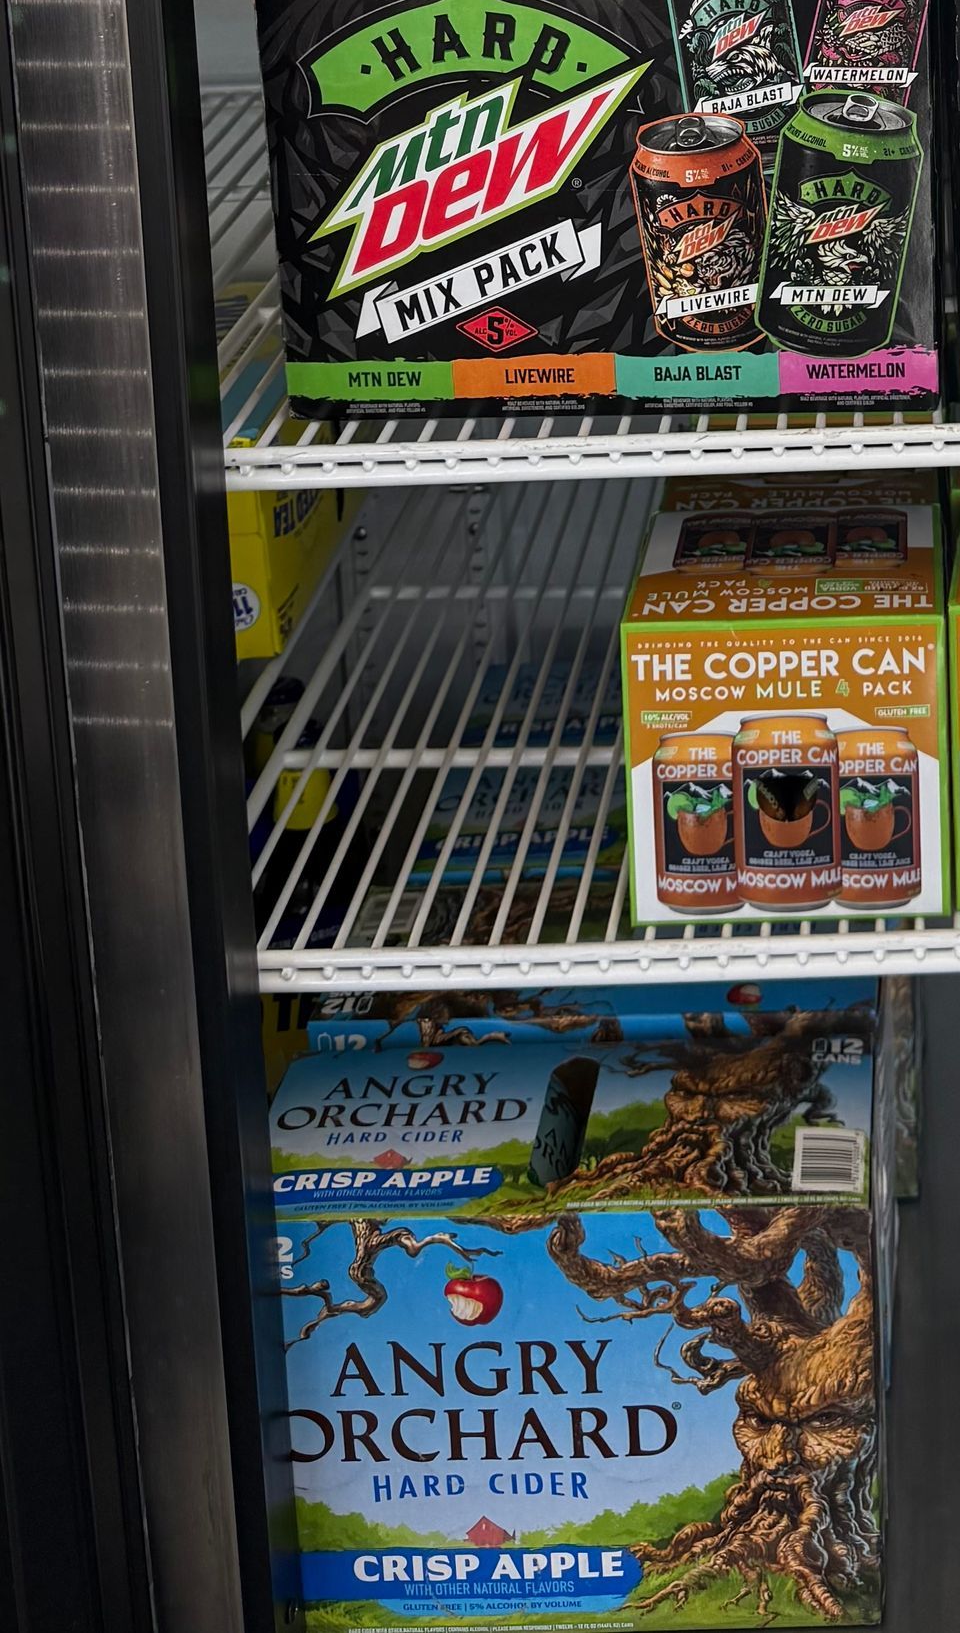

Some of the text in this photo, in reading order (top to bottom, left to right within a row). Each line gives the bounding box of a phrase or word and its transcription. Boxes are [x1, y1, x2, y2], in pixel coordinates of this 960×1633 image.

[370, 11, 572, 82] HARD
[814, 68, 905, 82] WATERMELON
[711, 86, 785, 114] BAJA BLAST
[393, 232, 567, 333] MIX PACK
[680, 287, 750, 314] LIVEWIRE
[791, 288, 868, 303] MTN DEW
[348, 371, 422, 387] MTN DEW
[505, 368, 576, 384] LIVEWIRE
[654, 365, 742, 382] BAJA BLAST
[806, 362, 906, 379] WATERMELON
[631, 647, 926, 681] THE COPPER CAN
[656, 679, 913, 703] MOSCOW MULE 4 PACK
[877, 707, 928, 717] GLUTEN FREE
[772, 731, 803, 746] THE
[810, 1051, 861, 1065] CANS
[324, 1071, 500, 1100] ANGRY
[277, 1098, 528, 1131] ORCHARD
[326, 1130, 464, 1146] HARD CIDER
[273, 1167, 493, 1192] CRISP APPLE
[330, 1340, 613, 1398] ANGRY
[289, 1404, 680, 1463] ORCHARD
[373, 1472, 589, 1503] HARD CIDER
[353, 1550, 625, 1583] CRISP APPLE
[404, 1580, 575, 1596] WITH OTHER NATURAL FLAVORS
